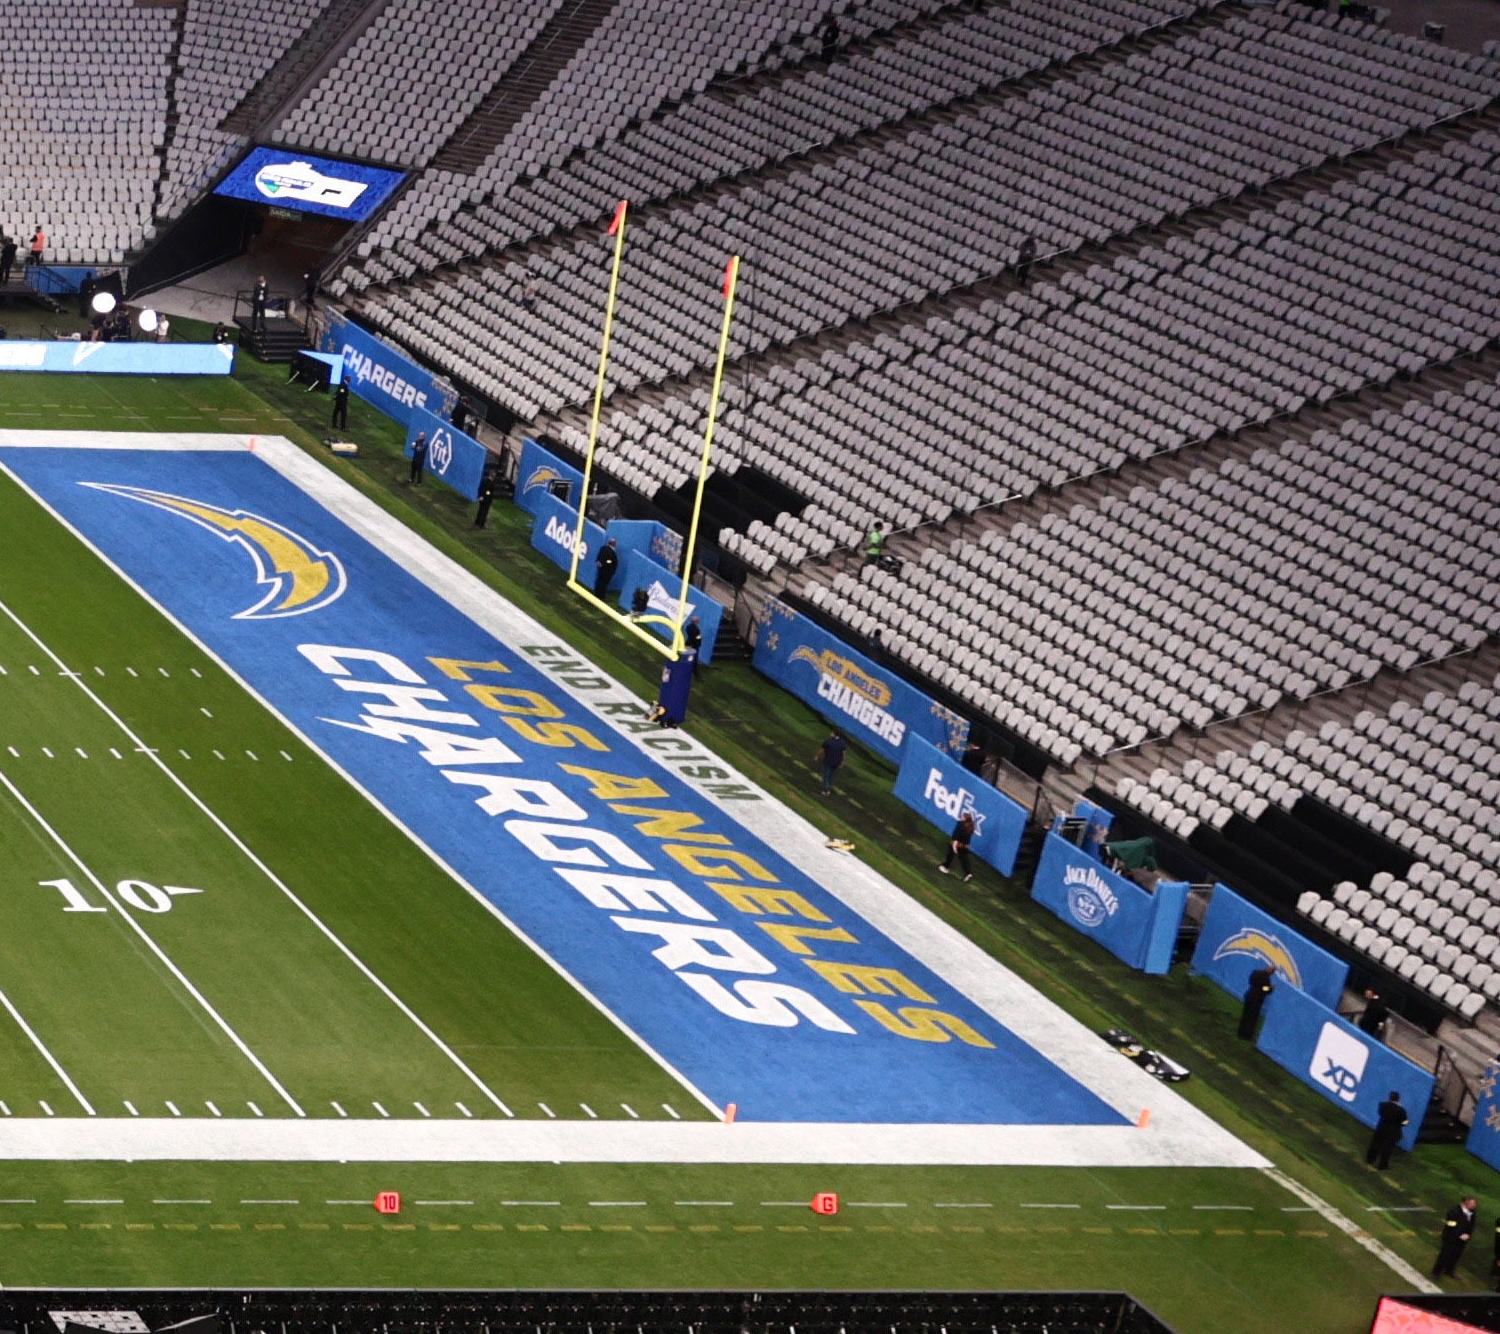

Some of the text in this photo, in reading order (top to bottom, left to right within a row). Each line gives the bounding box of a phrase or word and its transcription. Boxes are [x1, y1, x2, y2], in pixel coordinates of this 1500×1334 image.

[342, 344, 428, 408] CHARGERS
[828, 657, 844, 676] LOS
[519, 642, 764, 804] END RACISM
[817, 673, 906, 747] CHARGERS
[923, 767, 987, 837] FedEx
[295, 642, 859, 1036] CHARGERS
[424, 655, 997, 1049] LOS ANGELES
[39, 878, 174, 914] 10
[1063, 865, 1088, 886] JACK
[383, 1195, 396, 1210] 10
[823, 1197, 833, 1212] G
